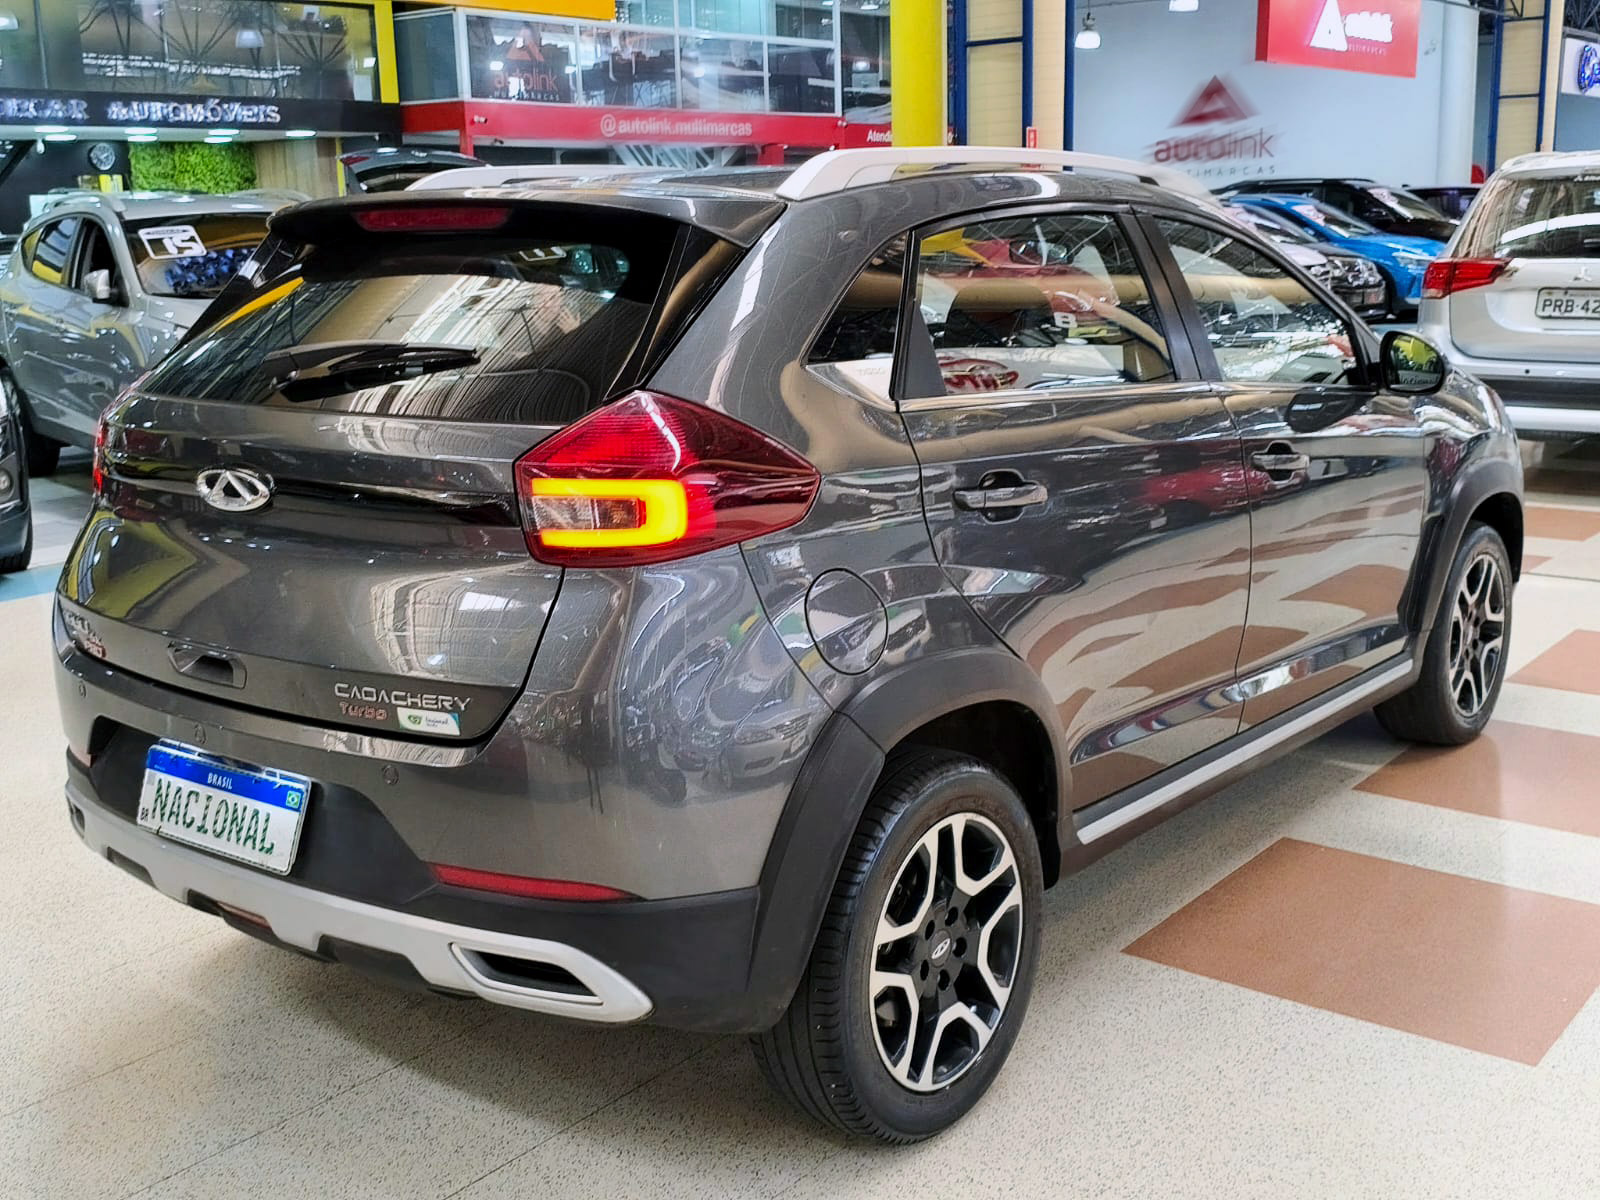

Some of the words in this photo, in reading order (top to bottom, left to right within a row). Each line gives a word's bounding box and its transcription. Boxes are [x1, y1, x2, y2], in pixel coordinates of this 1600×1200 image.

[1153, 128, 1274, 162] autolink
[207, 772, 233, 790] BRASIL
[151, 778, 275, 855] NACIONAL
